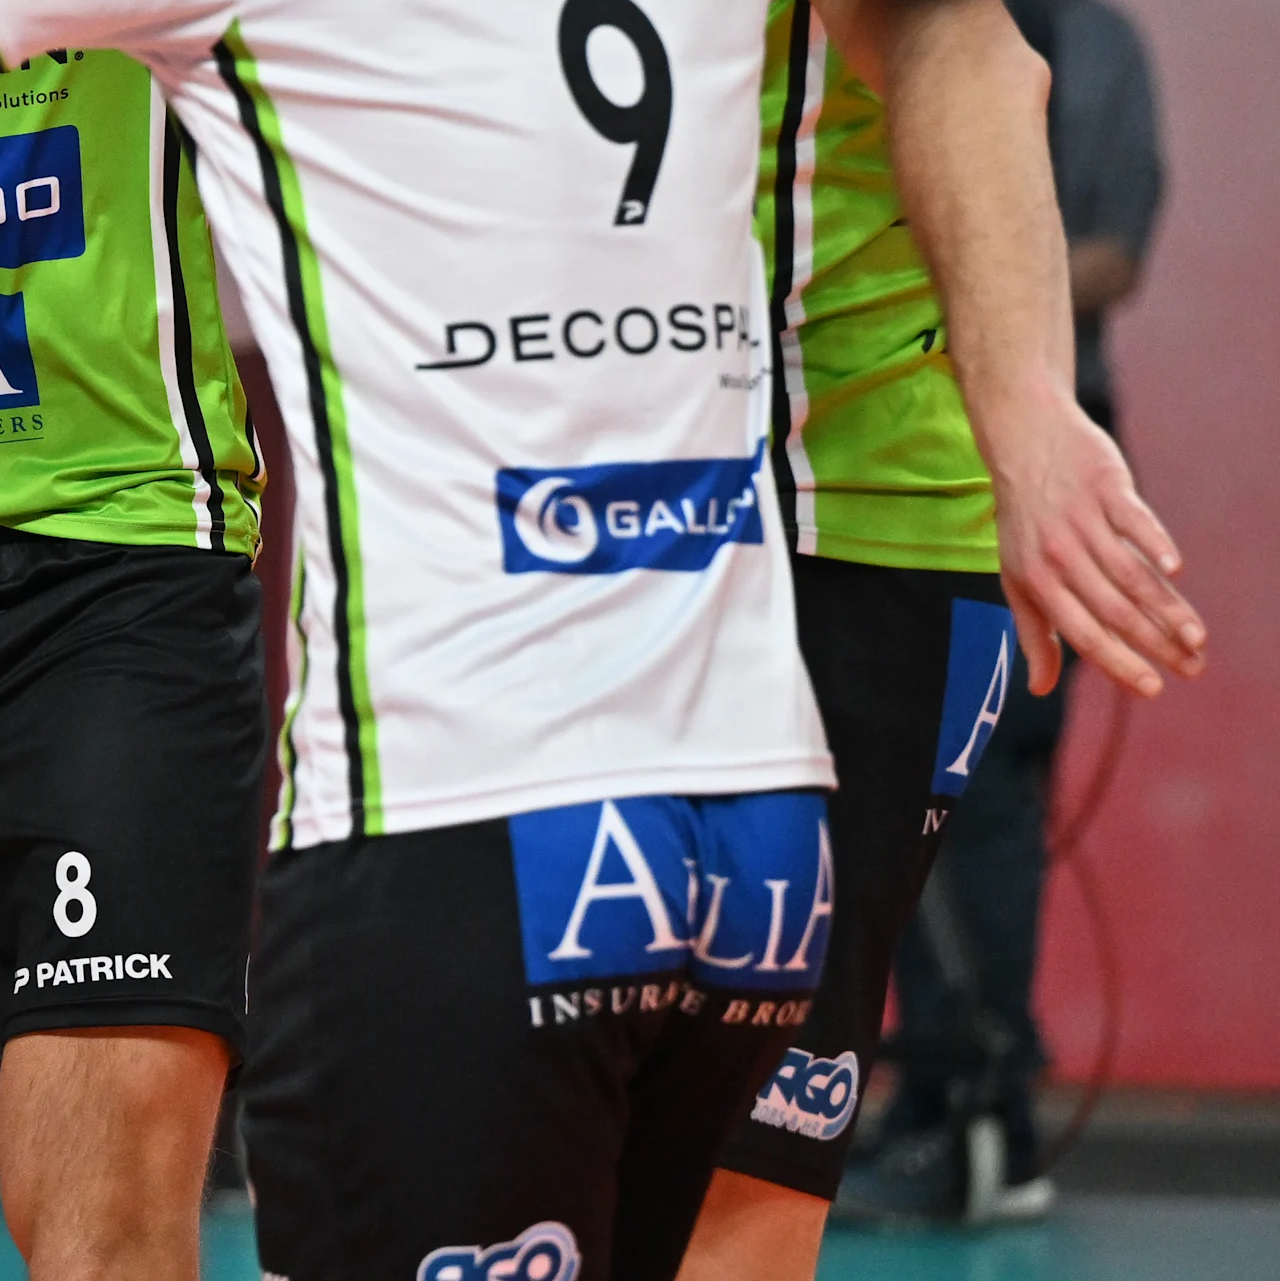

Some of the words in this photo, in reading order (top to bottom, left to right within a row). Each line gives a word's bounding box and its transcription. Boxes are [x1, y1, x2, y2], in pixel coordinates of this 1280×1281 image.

[53, 851, 97, 938] 8
[36, 953, 173, 989] PATRICK
[758, 1050, 852, 1119] AGO
